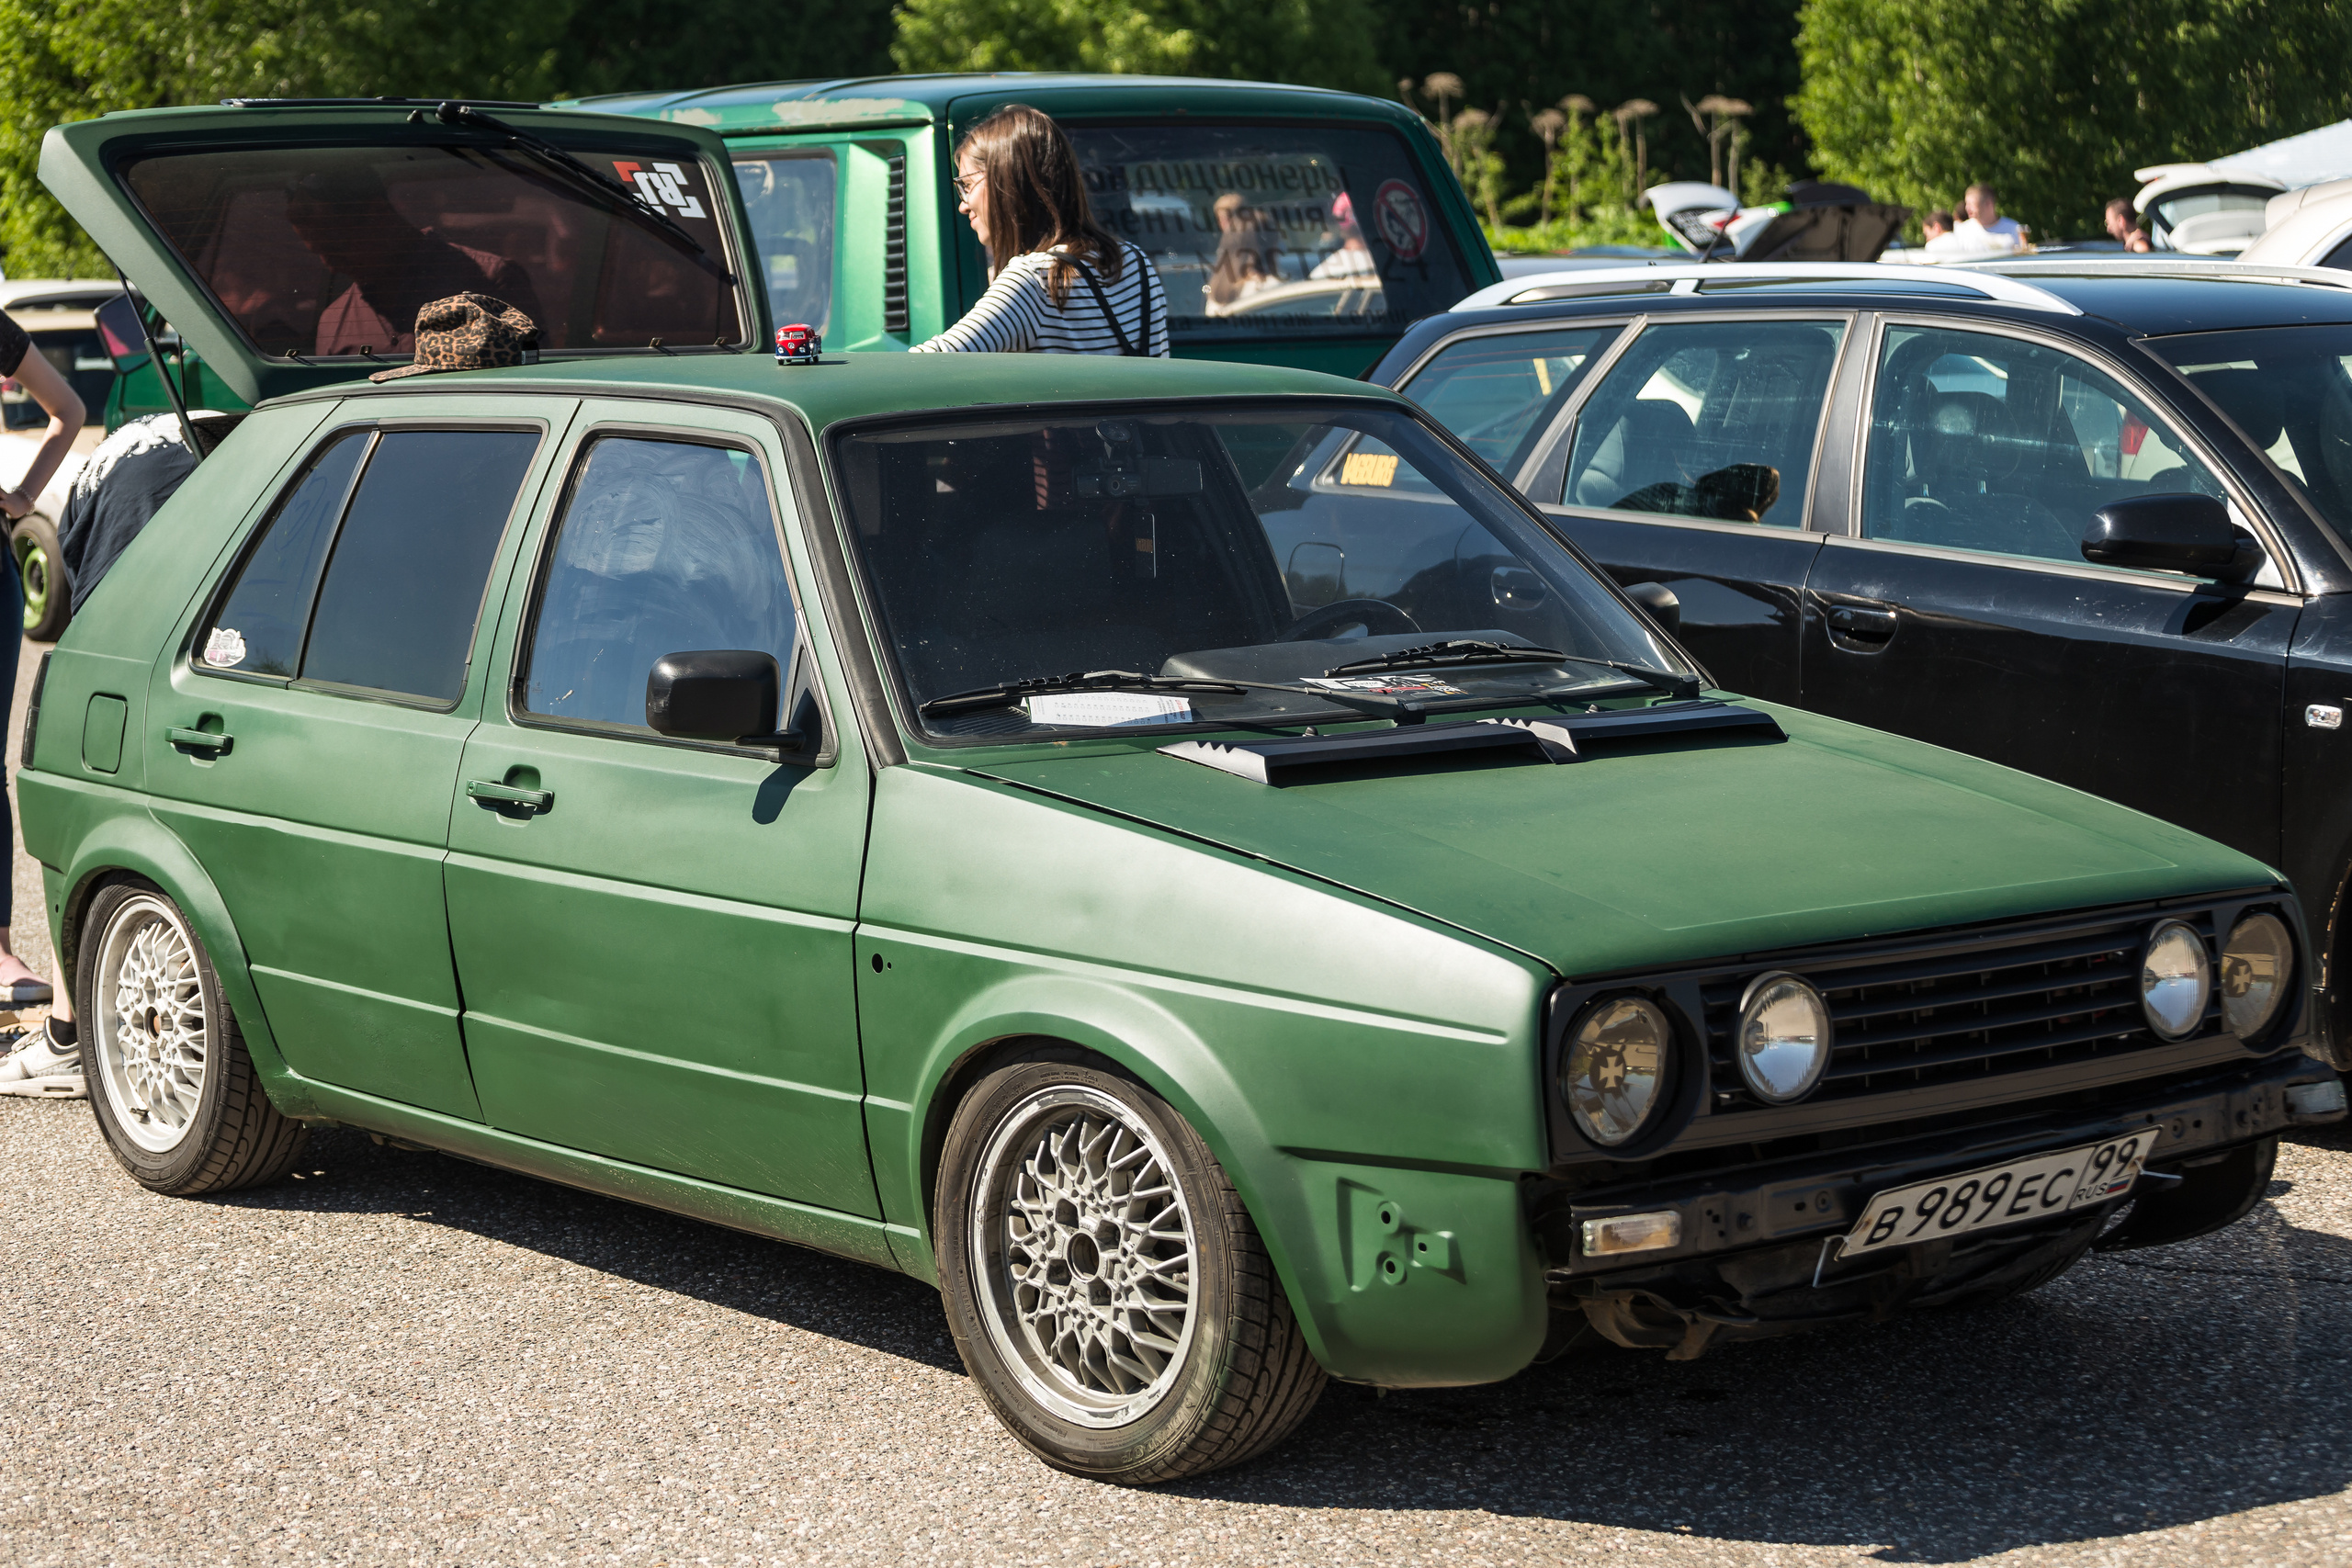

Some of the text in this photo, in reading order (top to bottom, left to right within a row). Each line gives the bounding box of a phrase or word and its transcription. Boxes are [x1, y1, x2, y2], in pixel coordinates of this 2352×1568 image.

[1082, 162, 1351, 197] ондиционеры
[1340, 452, 1399, 488] VAGBURG
[2090, 1136, 2139, 1184] 99
[2073, 1181, 2108, 1203] RUS
